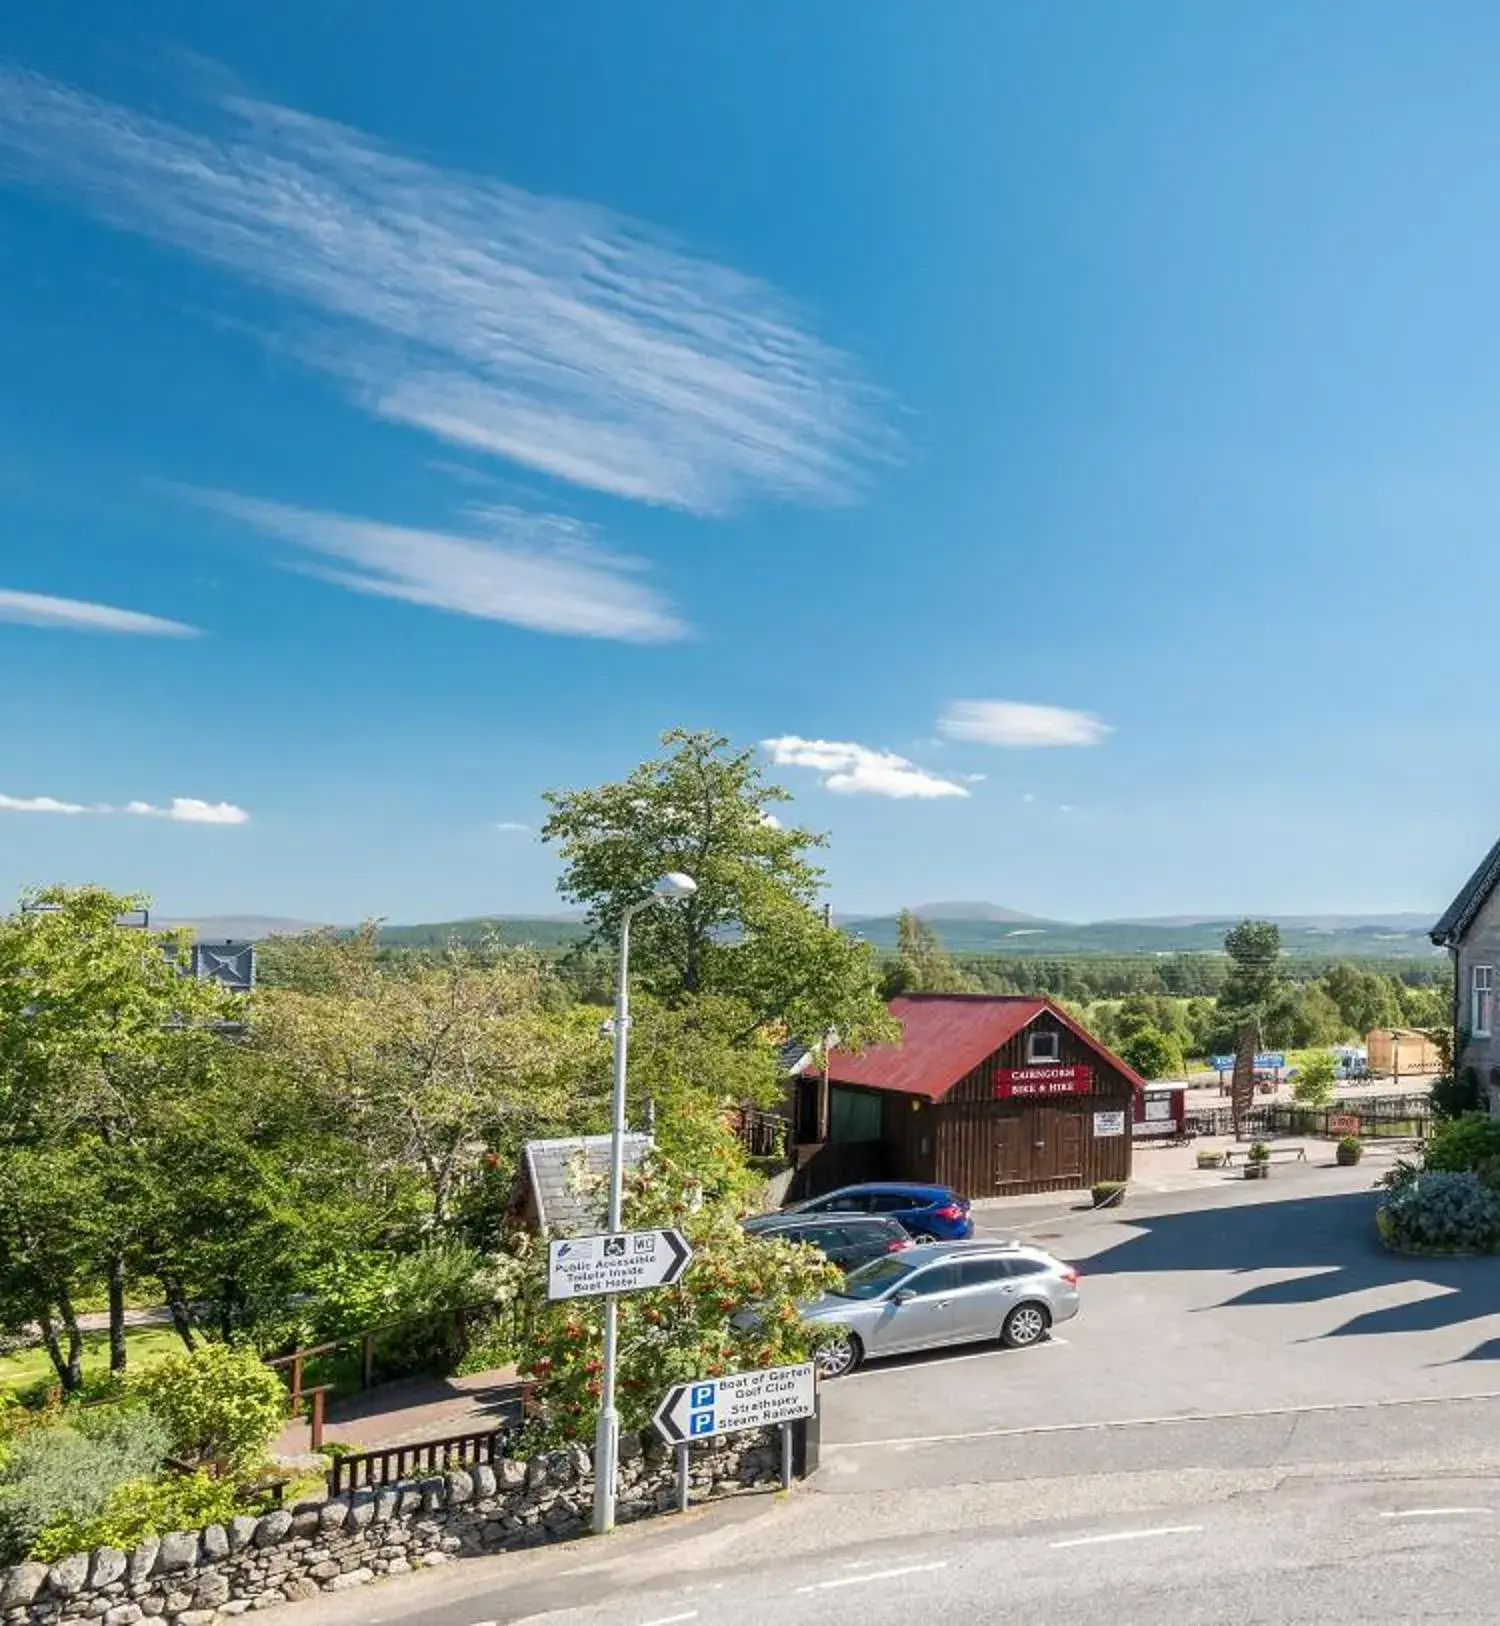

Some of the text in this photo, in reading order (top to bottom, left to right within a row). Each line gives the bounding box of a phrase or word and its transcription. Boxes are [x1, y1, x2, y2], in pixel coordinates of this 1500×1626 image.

[1011, 1068, 1075, 1080] CAIRNGORM
[1011, 1085, 1036, 1094] BIKE
[1049, 1082, 1074, 1092] HIKE
[555, 1255, 656, 1273] Public Accessible
[609, 1267, 644, 1277] Inside
[574, 1278, 637, 1292] Boat Hotel
[719, 1367, 811, 1391] Boat of Garten
[735, 1381, 795, 1399] Golf Club
[731, 1395, 798, 1415] Strathspey
[719, 1404, 809, 1429] Steam Railway
